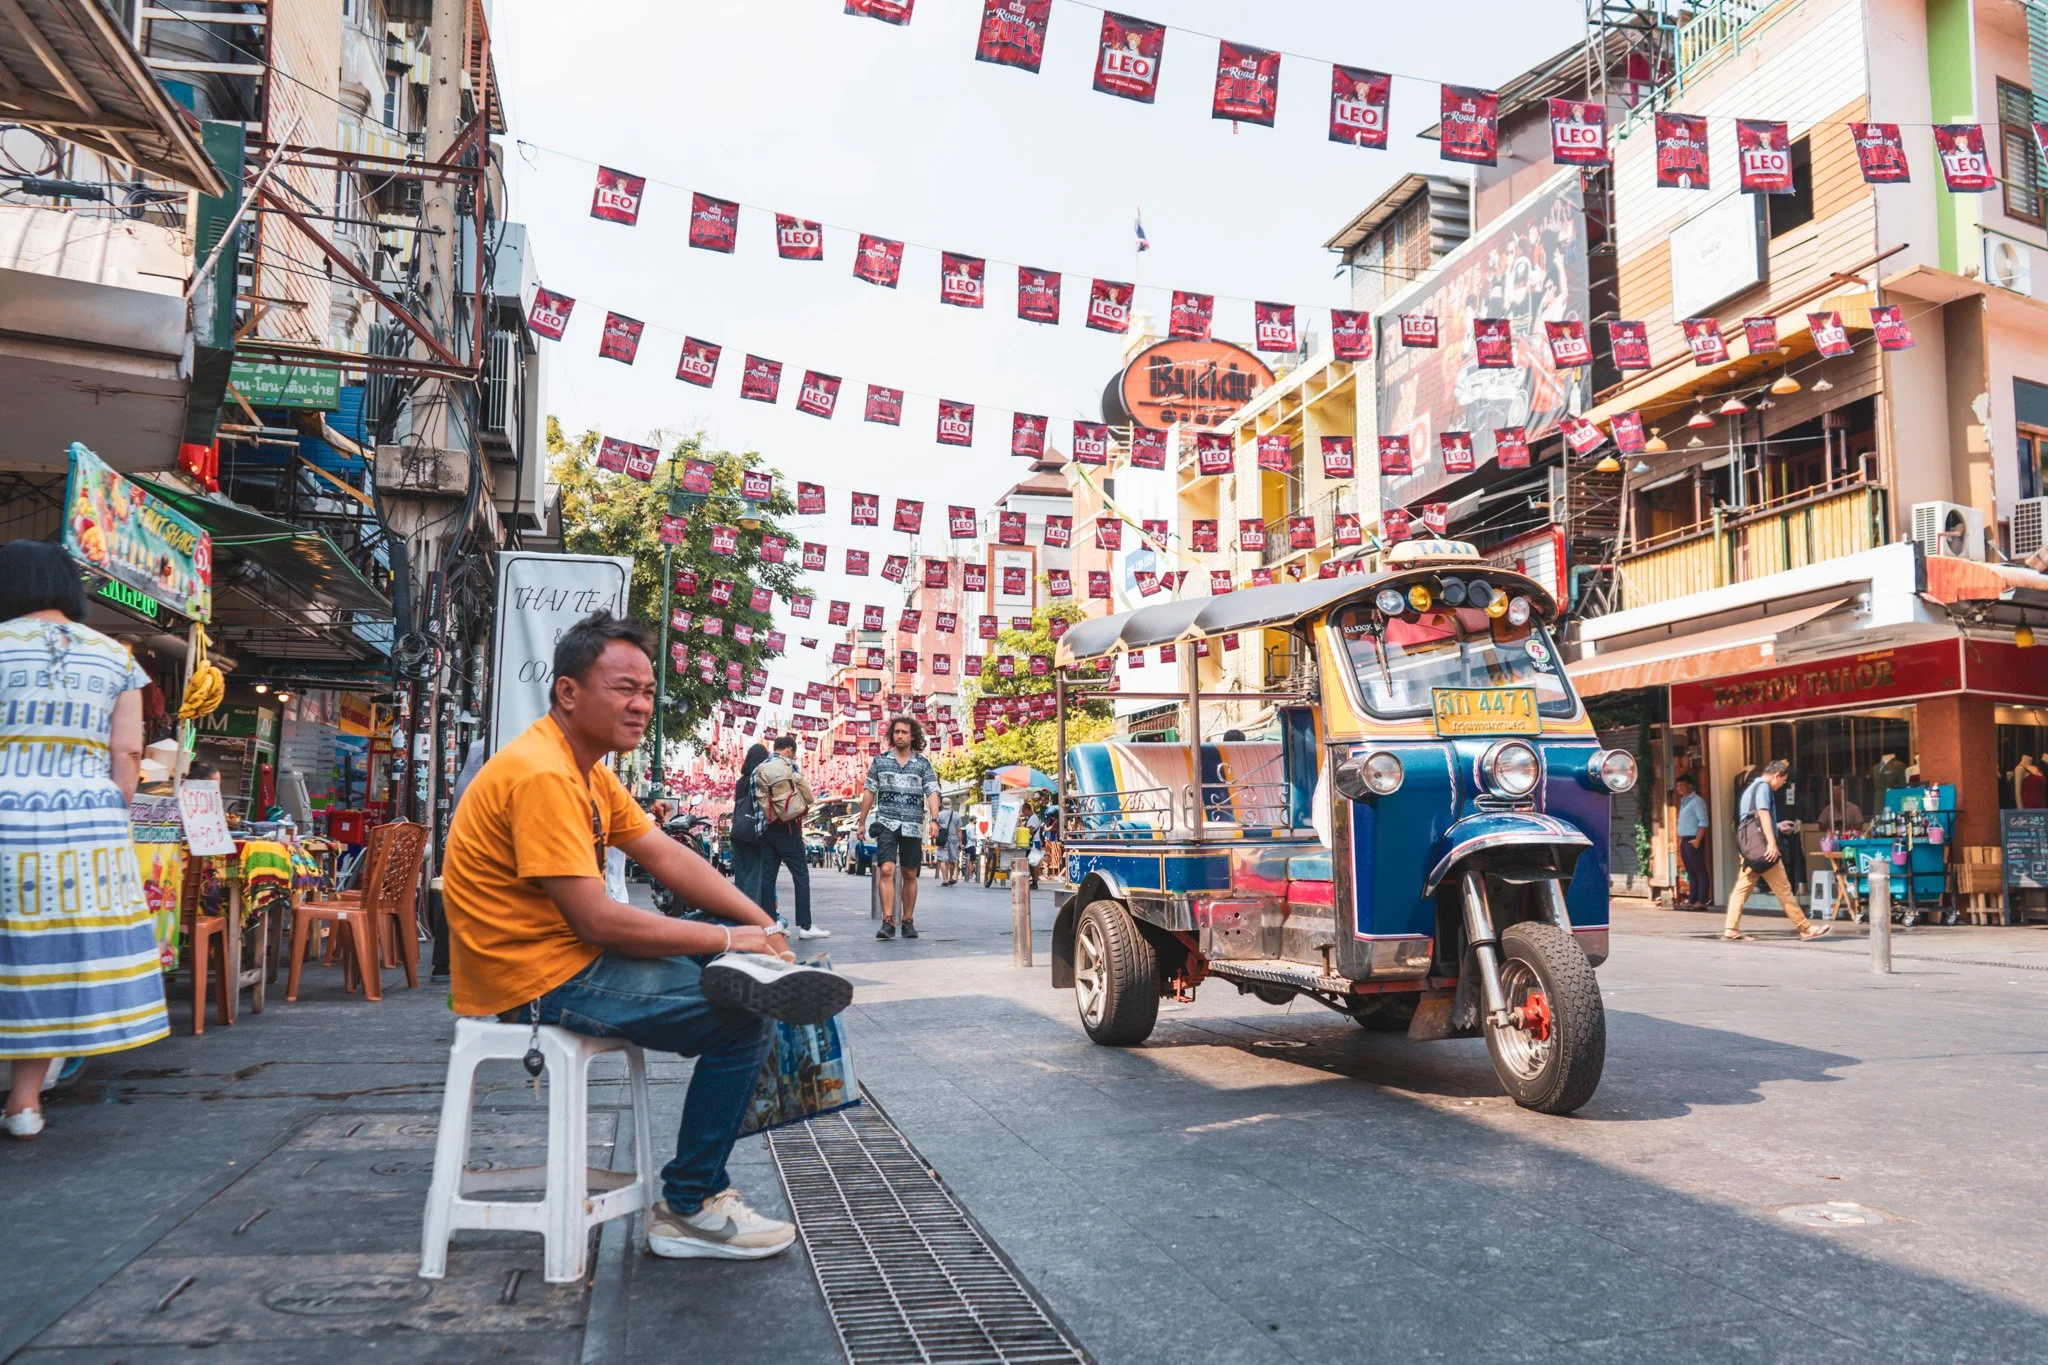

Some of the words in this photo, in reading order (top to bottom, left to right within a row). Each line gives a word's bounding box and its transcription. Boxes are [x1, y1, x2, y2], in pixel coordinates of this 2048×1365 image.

[996, 8, 1024, 22] Road
[1026, 19, 1035, 28] to
[983, 17, 1040, 56] 2024
[1108, 53, 1150, 76] LEO
[1229, 67, 1256, 80] Road
[1258, 73, 1268, 81] to
[1217, 76, 1274, 106] 2024
[1340, 104, 1378, 126] LEO
[1451, 111, 1475, 122] Road
[1477, 115, 1488, 123] to
[1443, 120, 1494, 150] 2024
[1560, 127, 1597, 144] LEO
[1666, 137, 1689, 148] Road
[1690, 140, 1700, 148] to
[1861, 138, 1883, 148] Road
[1659, 148, 1708, 174] 2024
[1750, 155, 1784, 170] LEO
[1859, 145, 1905, 168] 2024
[1948, 157, 1980, 172] LEO
[602, 191, 633, 208] LEO
[700, 212, 721, 221] Road
[721, 216, 730, 224] to
[784, 231, 814, 244] LEO
[948, 278, 976, 293] LEO
[1026, 285, 1045, 294] Road
[1096, 302, 1123, 319] LEO
[536, 311, 561, 327] LEO
[1262, 326, 1288, 340] LEO
[1406, 321, 1432, 332] LEO
[1819, 330, 1844, 344] LEO
[1557, 341, 1581, 354] LEO
[1695, 339, 1716, 352] LEO
[256, 354, 317, 377] ATM
[685, 359, 710, 374] LEO
[806, 390, 829, 405] LEO
[943, 421, 966, 433] LEO
[1078, 441, 1100, 452] LEO
[1205, 452, 1227, 463] LEO
[1328, 456, 1348, 466] LEO
[1449, 451, 1469, 461] LEO
[631, 459, 650, 471] LEO
[748, 481, 767, 491] LEO
[855, 508, 874, 516] LEO
[139, 504, 170, 537] FRUIT
[164, 521, 197, 556] SHAKE
[954, 520, 972, 529] LEO
[1049, 529, 1066, 538] LEO
[1243, 534, 1260, 542] LEO
[1340, 529, 1358, 537] LEO
[715, 538, 732, 547] LEO
[1414, 541, 1472, 555] TAXI
[806, 555, 822, 563] LEO
[887, 566, 901, 575] LEO
[1052, 581, 1068, 589] LEO
[514, 585, 569, 612] THAI
[574, 588, 616, 613] TEA
[713, 590, 728, 599] LEO
[794, 604, 808, 612] LEO
[867, 616, 881, 624] LEO
[940, 618, 953, 626] LEO
[553, 627, 563, 646] &
[1000, 664, 1013, 672] LEO
[1714, 675, 1798, 709] BOSTON
[1804, 661, 1893, 696] TAILOR
[1478, 690, 1531, 715] 4471
